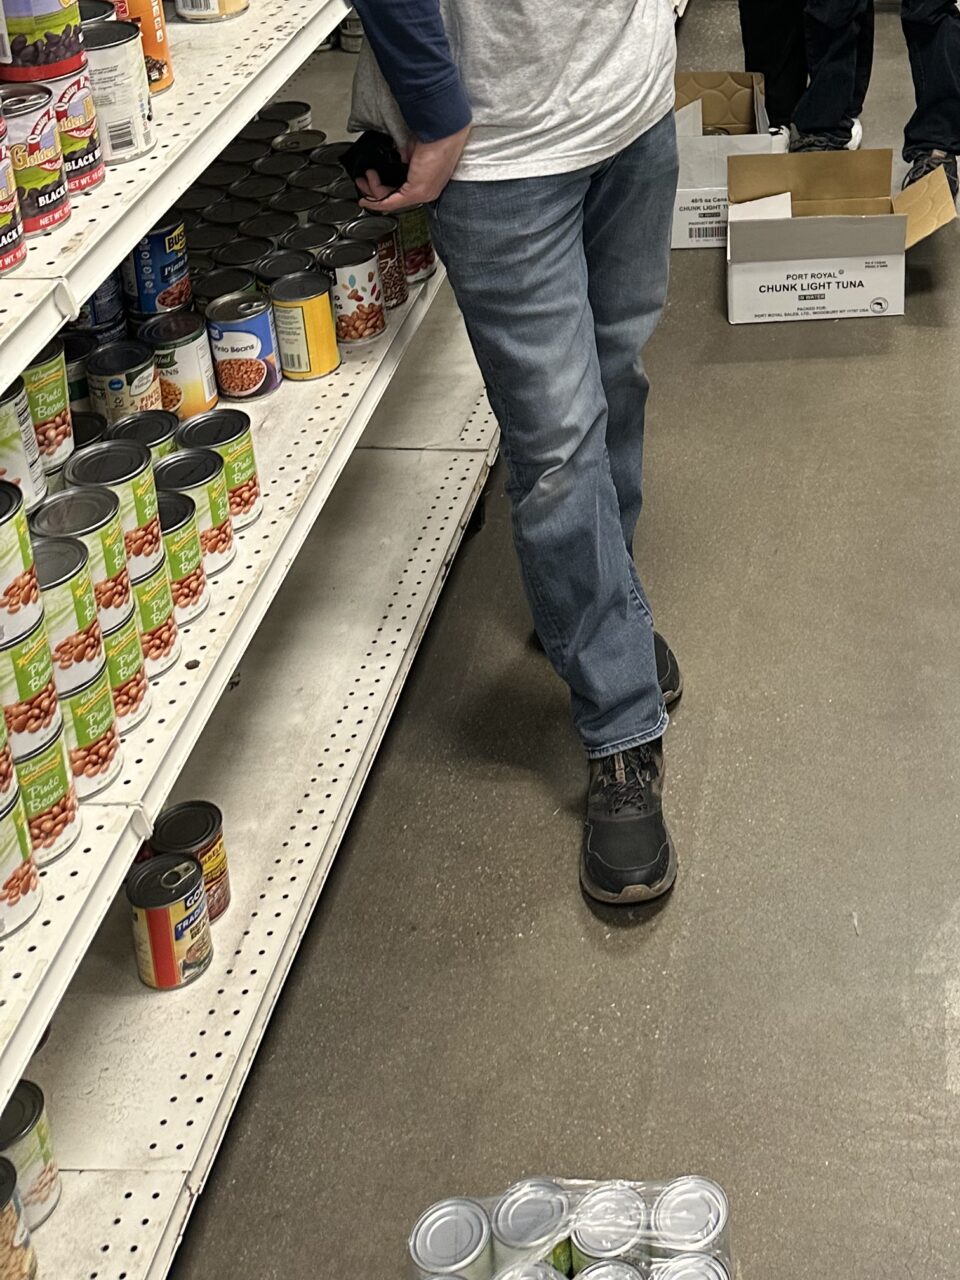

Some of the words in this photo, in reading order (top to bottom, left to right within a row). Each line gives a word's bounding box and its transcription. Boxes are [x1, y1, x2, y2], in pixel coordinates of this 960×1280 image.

[10, 143, 56, 171] Golden
[65, 151, 93, 172] BLACK
[37, 185, 66, 209] BLACK
[786, 273, 808, 281] PORT
[810, 271, 838, 280] ROYAL
[758, 283, 798, 294] CHUNK
[800, 281, 833, 292] LIGHT
[835, 280, 865, 290] TUNA
[230, 343, 255, 354] Beans
[35, 387, 62, 406] Pinto
[34, 398, 65, 419] Beans
[27, 775, 60, 798] Pinto
[27, 786, 64, 813] Beans
